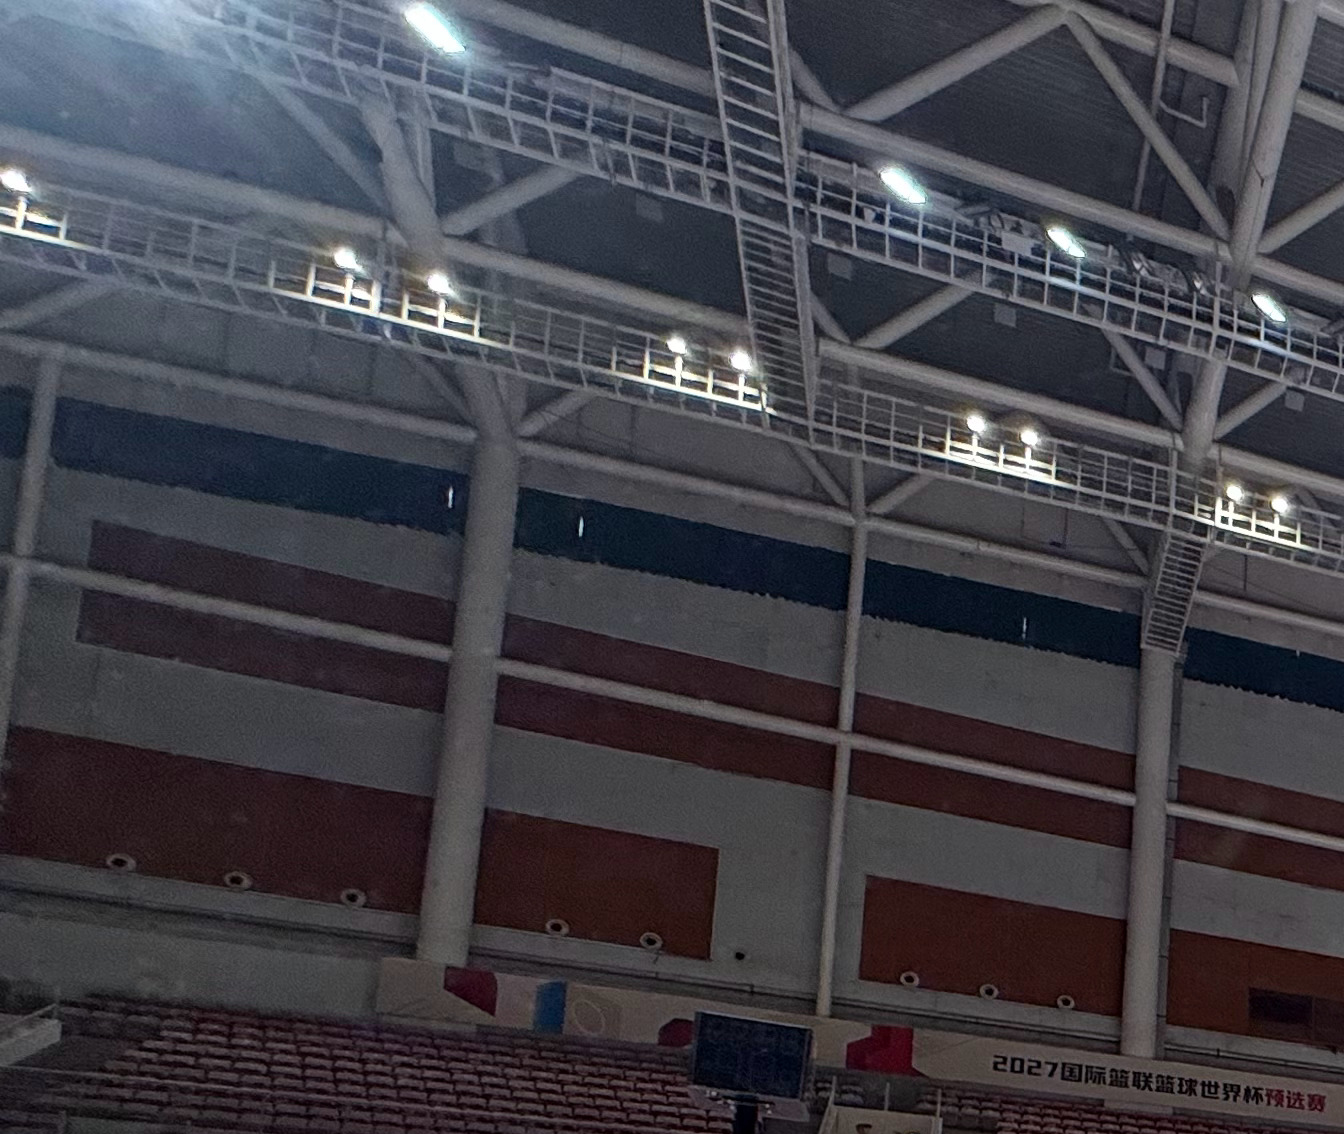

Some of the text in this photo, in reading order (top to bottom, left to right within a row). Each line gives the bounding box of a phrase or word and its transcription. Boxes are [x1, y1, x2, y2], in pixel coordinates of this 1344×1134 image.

[992, 1055, 1326, 1112] 2027国际篮联篮球世界杯预选赛
